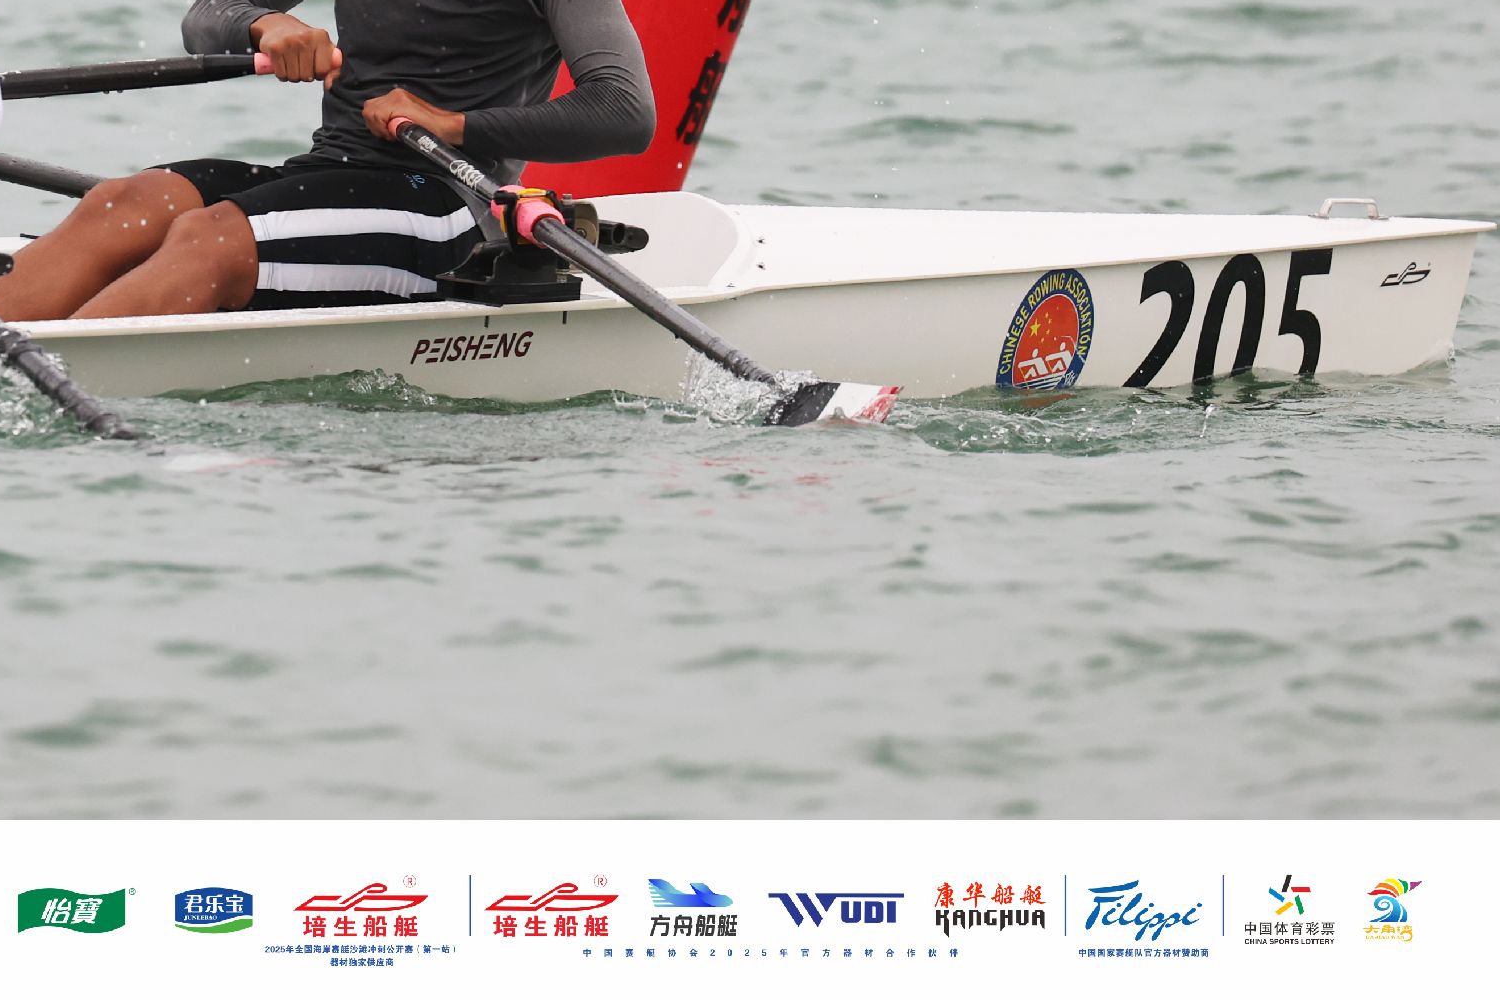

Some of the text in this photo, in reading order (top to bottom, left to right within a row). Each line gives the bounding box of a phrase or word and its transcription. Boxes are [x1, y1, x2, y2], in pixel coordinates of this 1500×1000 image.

[410, 331, 534, 365] PEISHENG
[1000, 272, 1092, 375] CHINESE ROWING ASSOCIATION
[1121, 248, 1334, 387] 205
